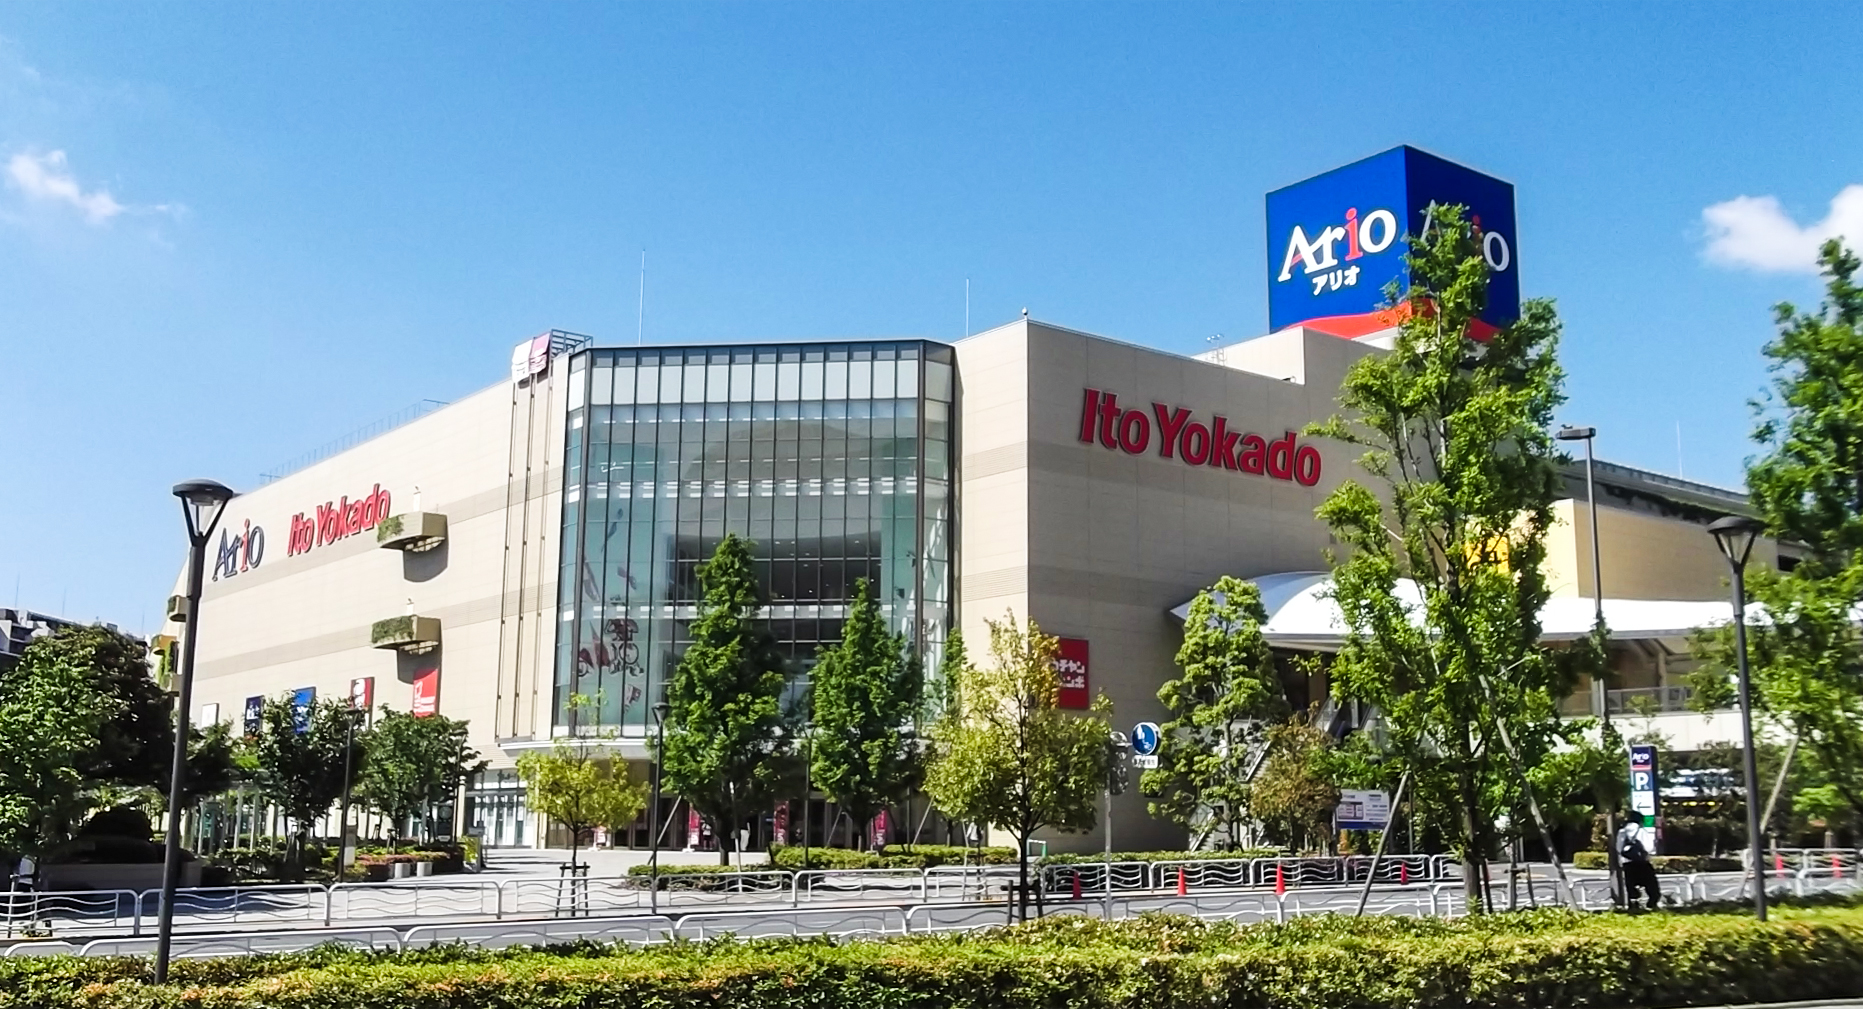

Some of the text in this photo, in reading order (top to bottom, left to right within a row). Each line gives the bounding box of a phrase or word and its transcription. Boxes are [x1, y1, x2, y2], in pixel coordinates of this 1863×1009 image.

[1277, 207, 1397, 282] Ario
[1311, 265, 1360, 296] アリオ
[1079, 387, 1322, 487] Ito Yokado
[211, 518, 265, 582] Ario
[287, 483, 391, 557] Ito Yokado
[1635, 772, 1650, 791] P
